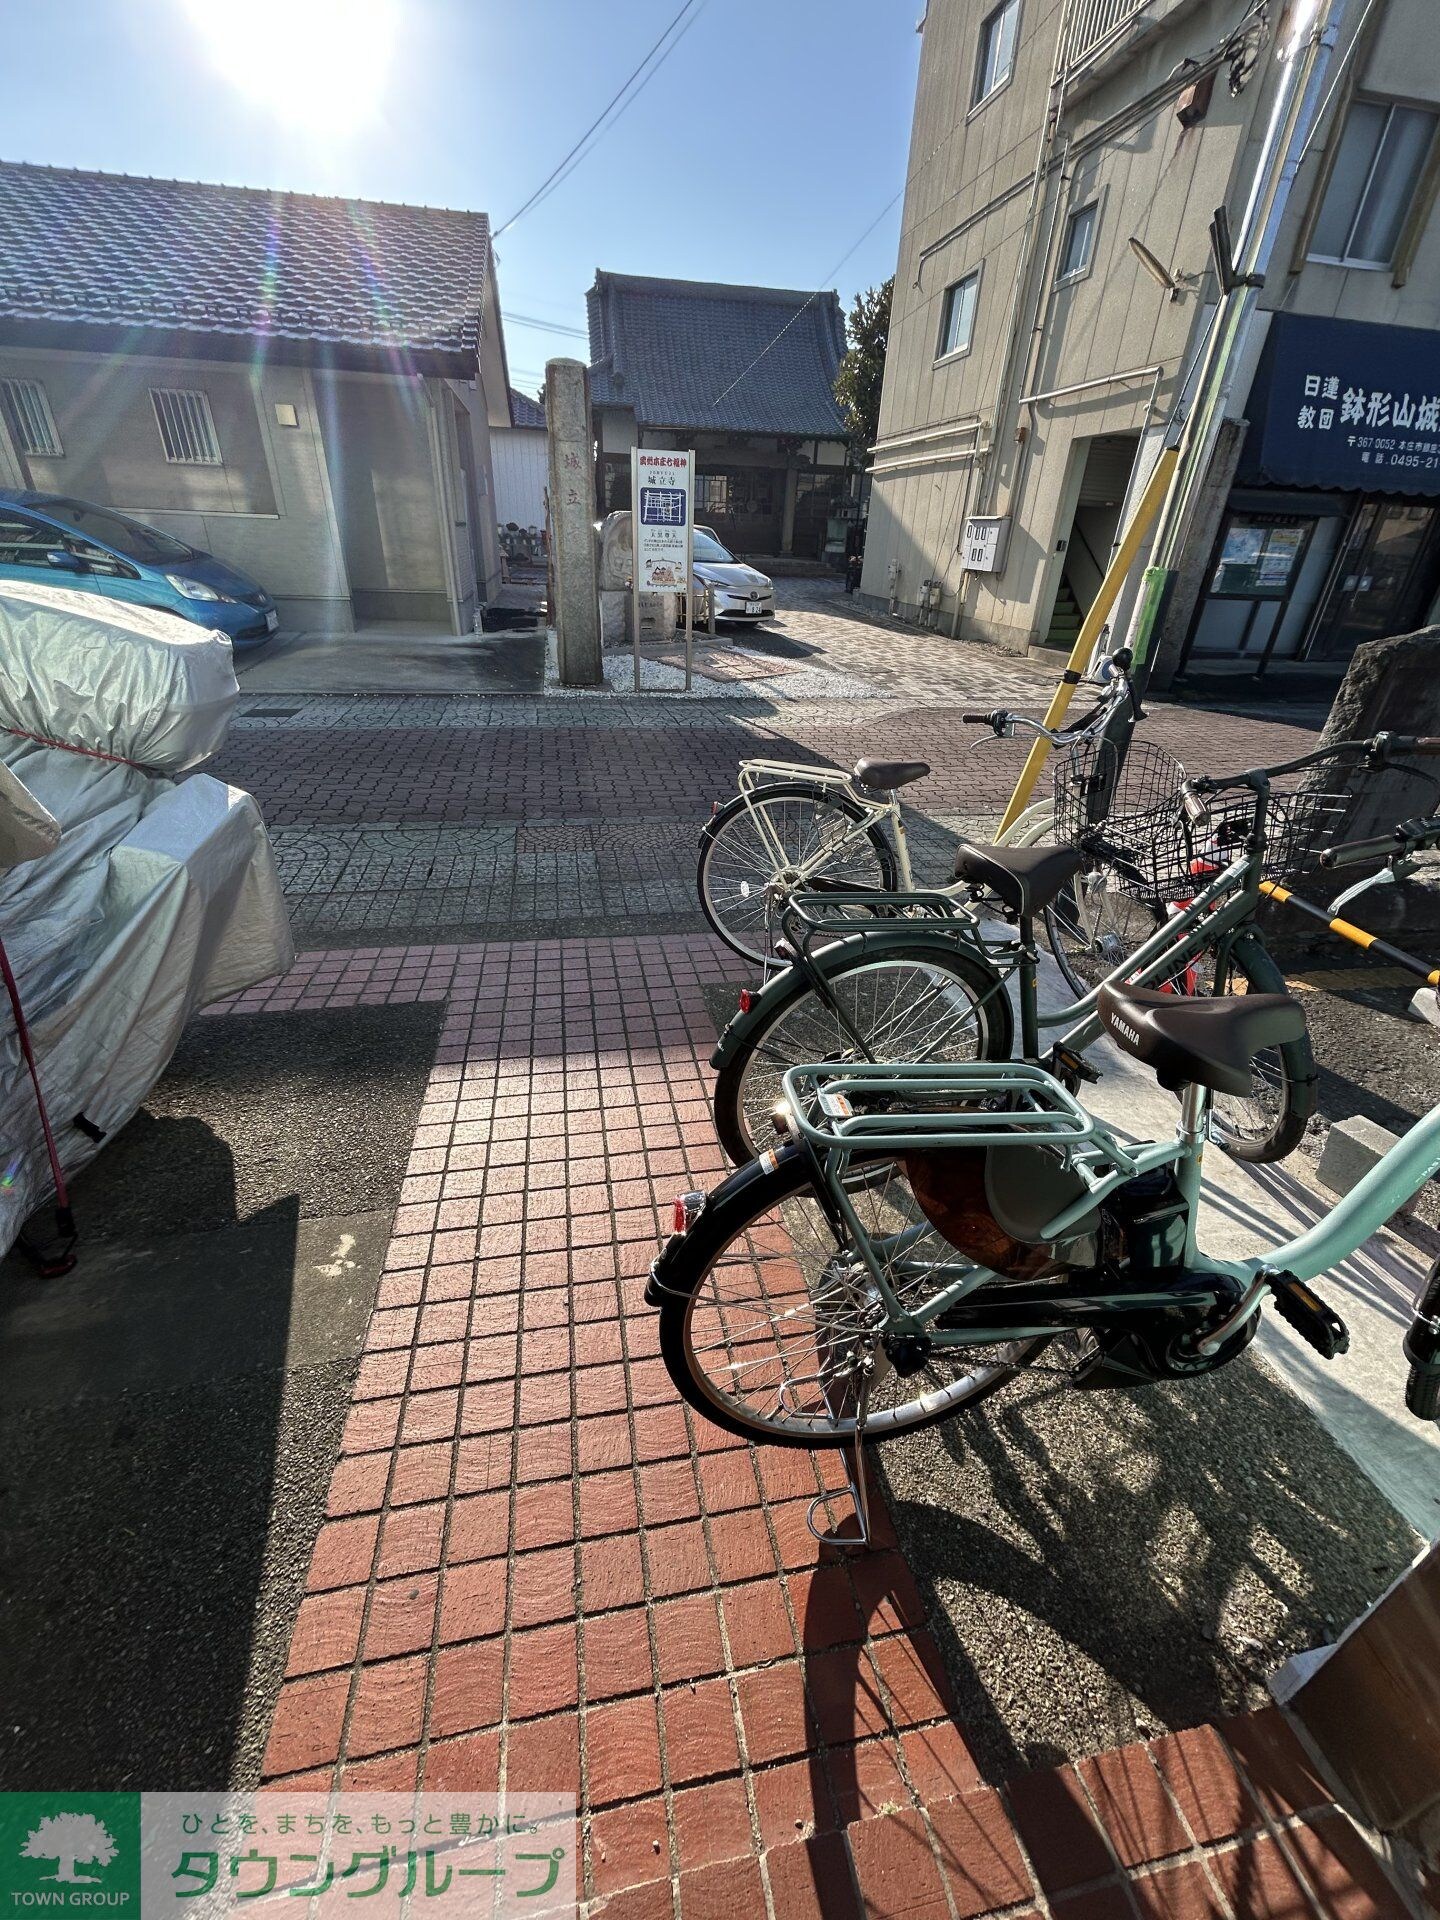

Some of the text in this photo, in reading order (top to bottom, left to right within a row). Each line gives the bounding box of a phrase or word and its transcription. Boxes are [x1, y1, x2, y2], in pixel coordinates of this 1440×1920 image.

[1304, 374, 1340, 401] 日蓮
[1297, 405, 1335, 430] 教団
[1340, 386, 1440, 433] 鉢形山城
[1389, 453, 1440, 469] 0495-21
[647, 475, 676, 486] 城立寺
[1109, 1012, 1140, 1046] YAMAHA
